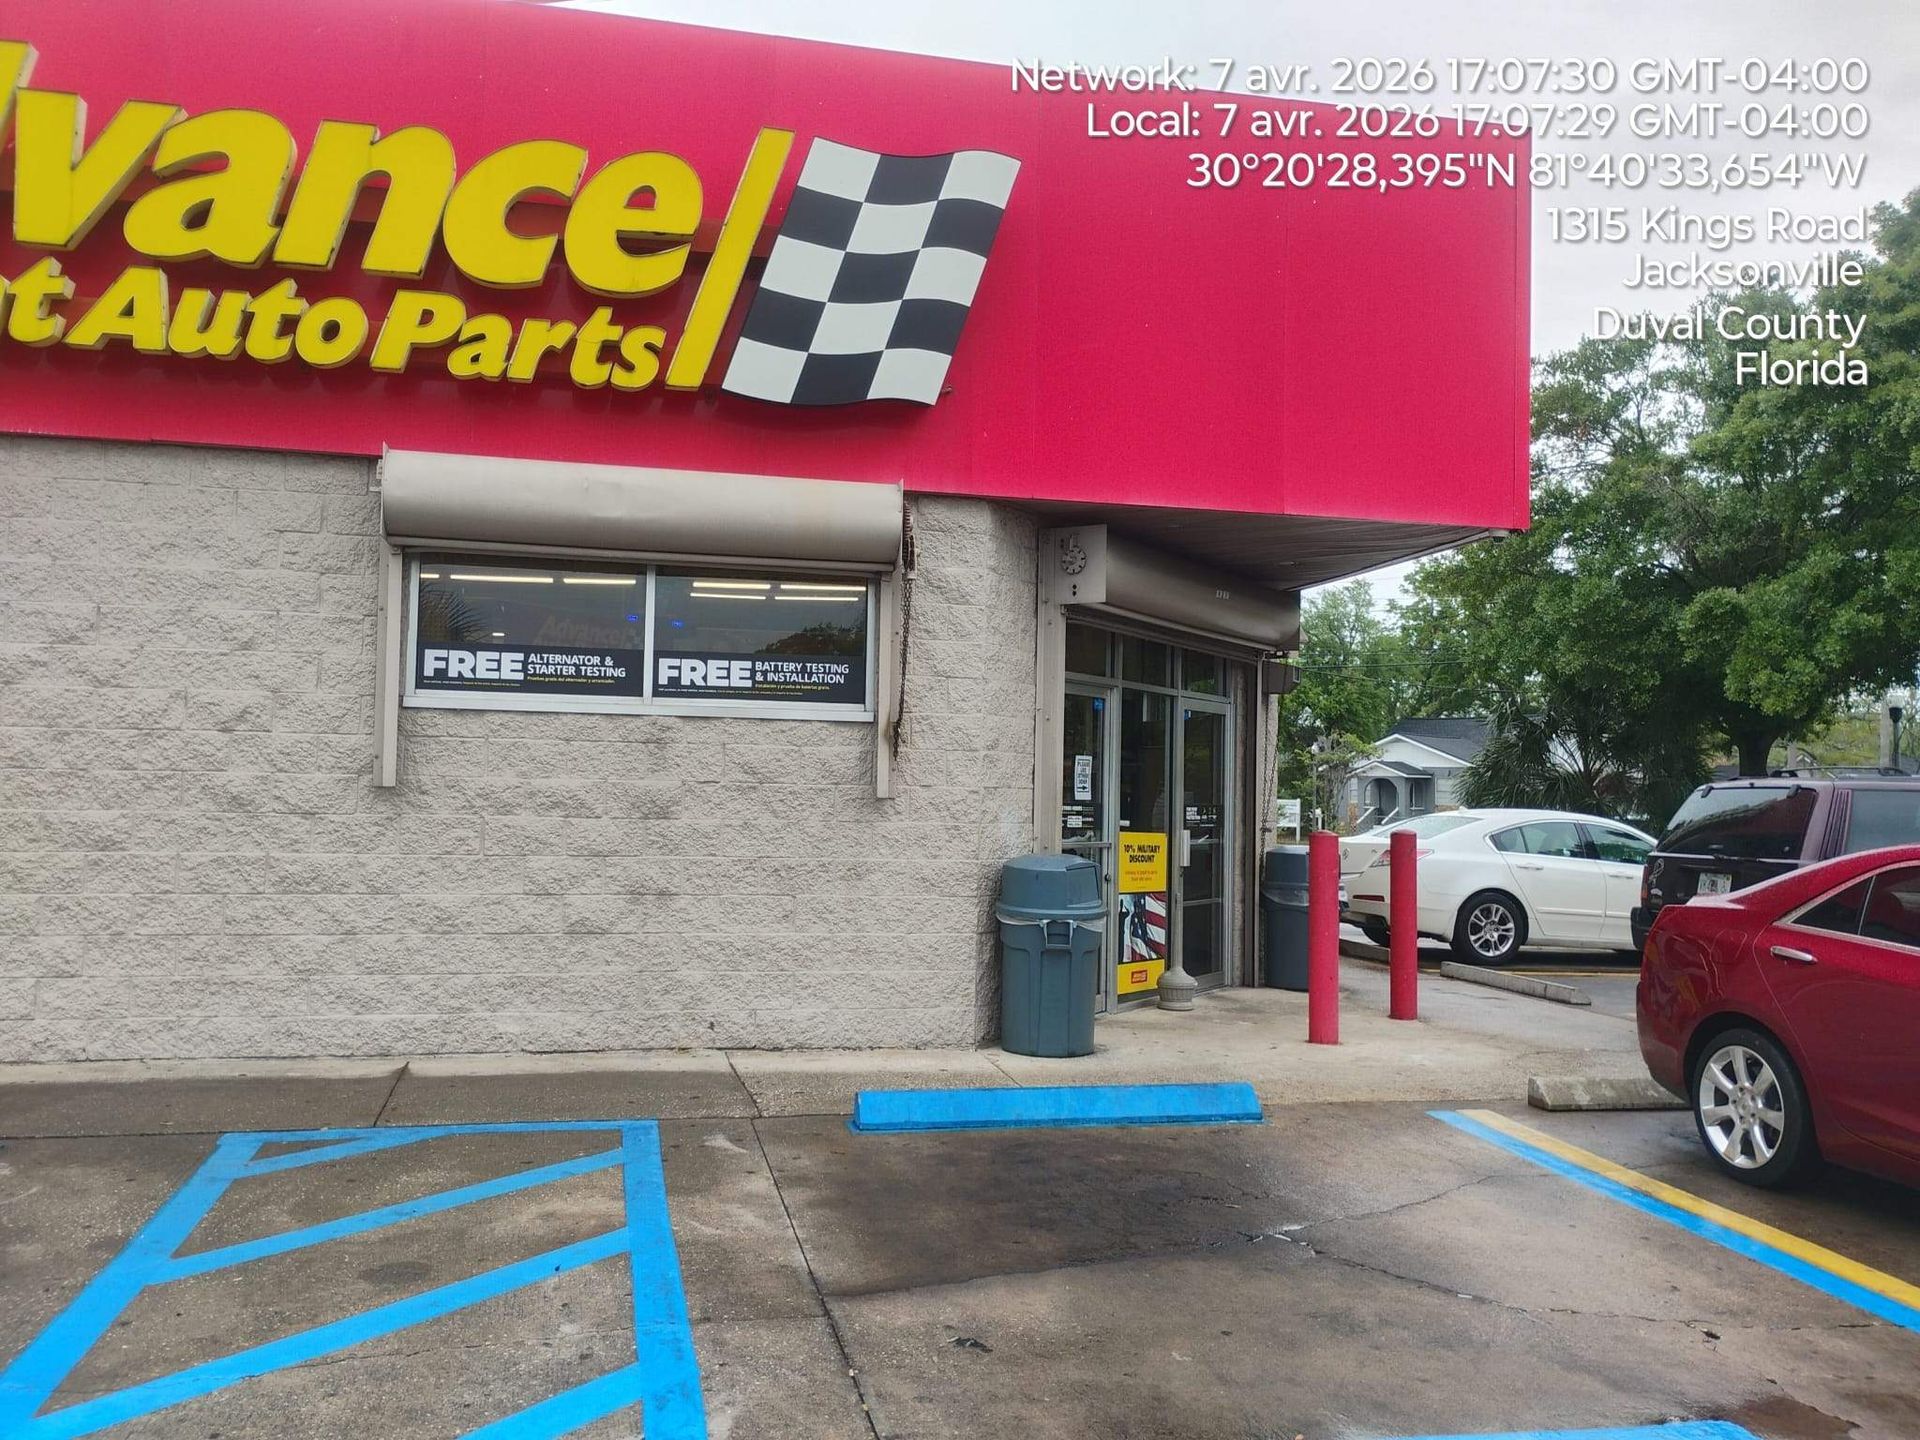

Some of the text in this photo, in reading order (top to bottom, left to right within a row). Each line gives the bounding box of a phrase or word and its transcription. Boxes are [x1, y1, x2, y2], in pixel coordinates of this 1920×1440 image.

[65, 264, 367, 368] Auto
[369, 290, 667, 391] Parts
[423, 649, 524, 680] FREE
[528, 653, 614, 667] ALTERNATOR &
[527, 664, 626, 678] STARTER TESTING
[658, 658, 752, 687] FREE
[755, 661, 849, 674] BATTERY TESTING
[755, 672, 845, 684] & INSTALLATION
[1137, 844, 1160, 854] MILITARY
[1129, 854, 1155, 863] DISCOUNT
